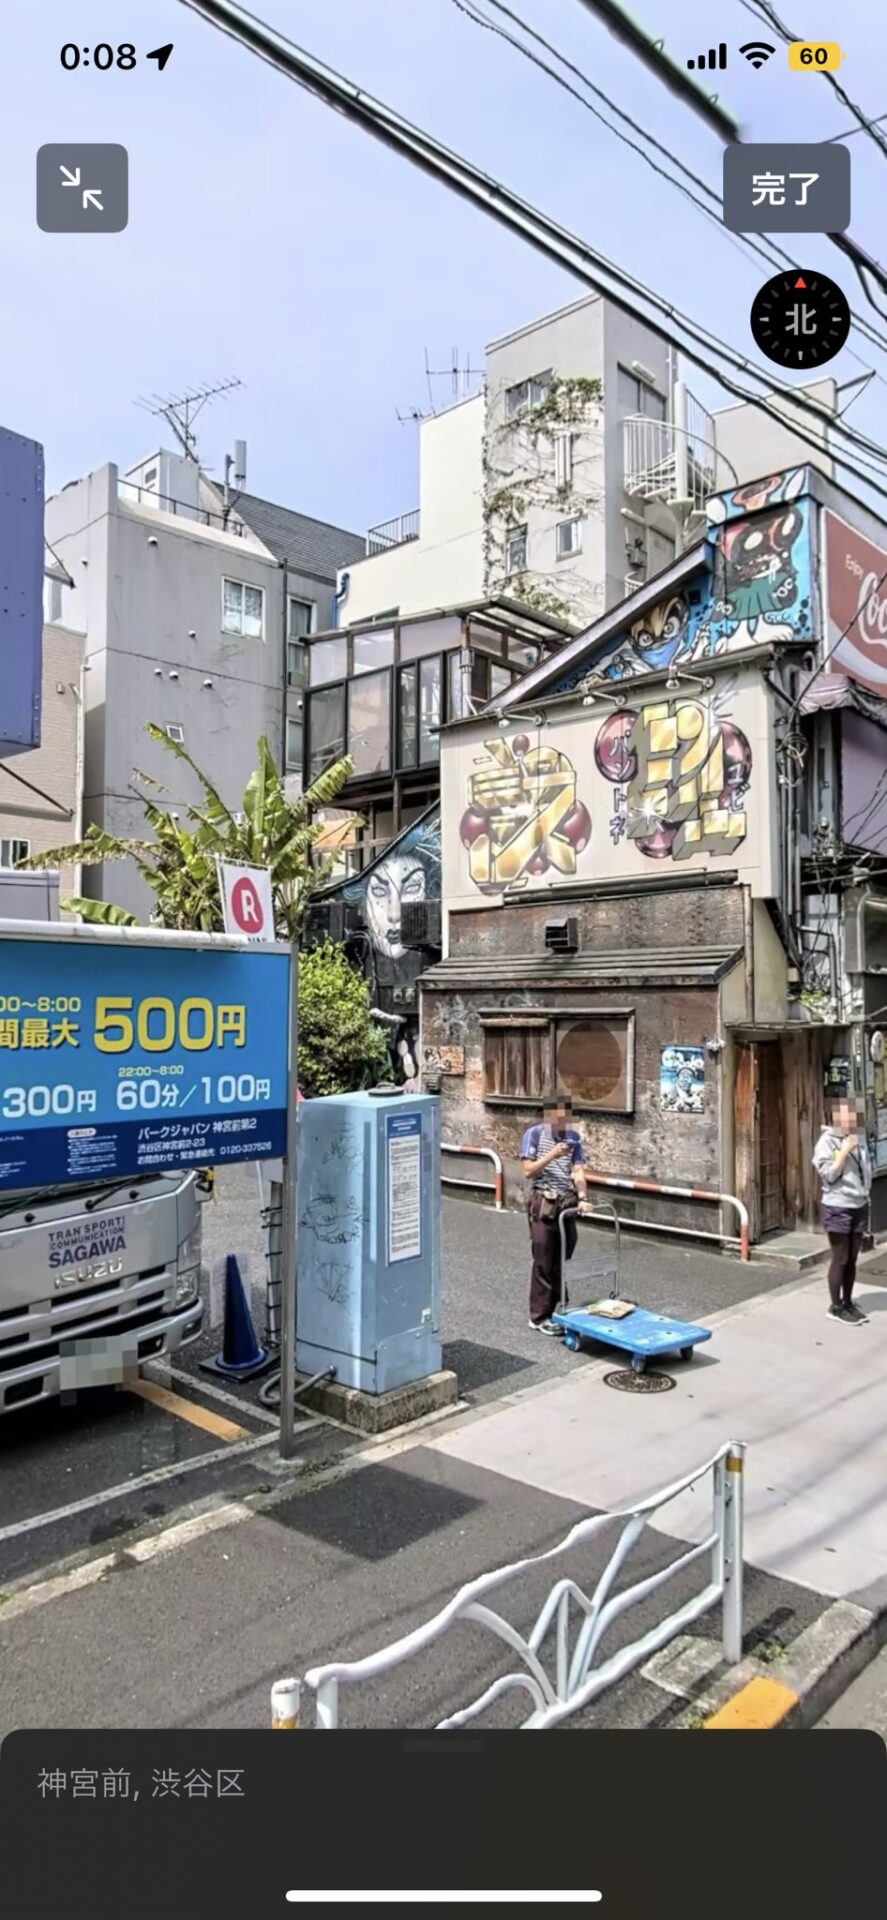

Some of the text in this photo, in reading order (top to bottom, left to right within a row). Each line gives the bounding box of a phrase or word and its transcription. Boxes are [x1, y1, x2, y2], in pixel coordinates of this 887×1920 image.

[0, 996, 247, 1053] 間最大 500円
[2, 1084, 97, 1118] 300円
[137, 1121, 211, 1140] パークジャパン
[48, 1235, 126, 1269] SAGAWA
[50, 1226, 125, 1250] COMMUNICATION
[54, 1257, 123, 1290] ISUZU
